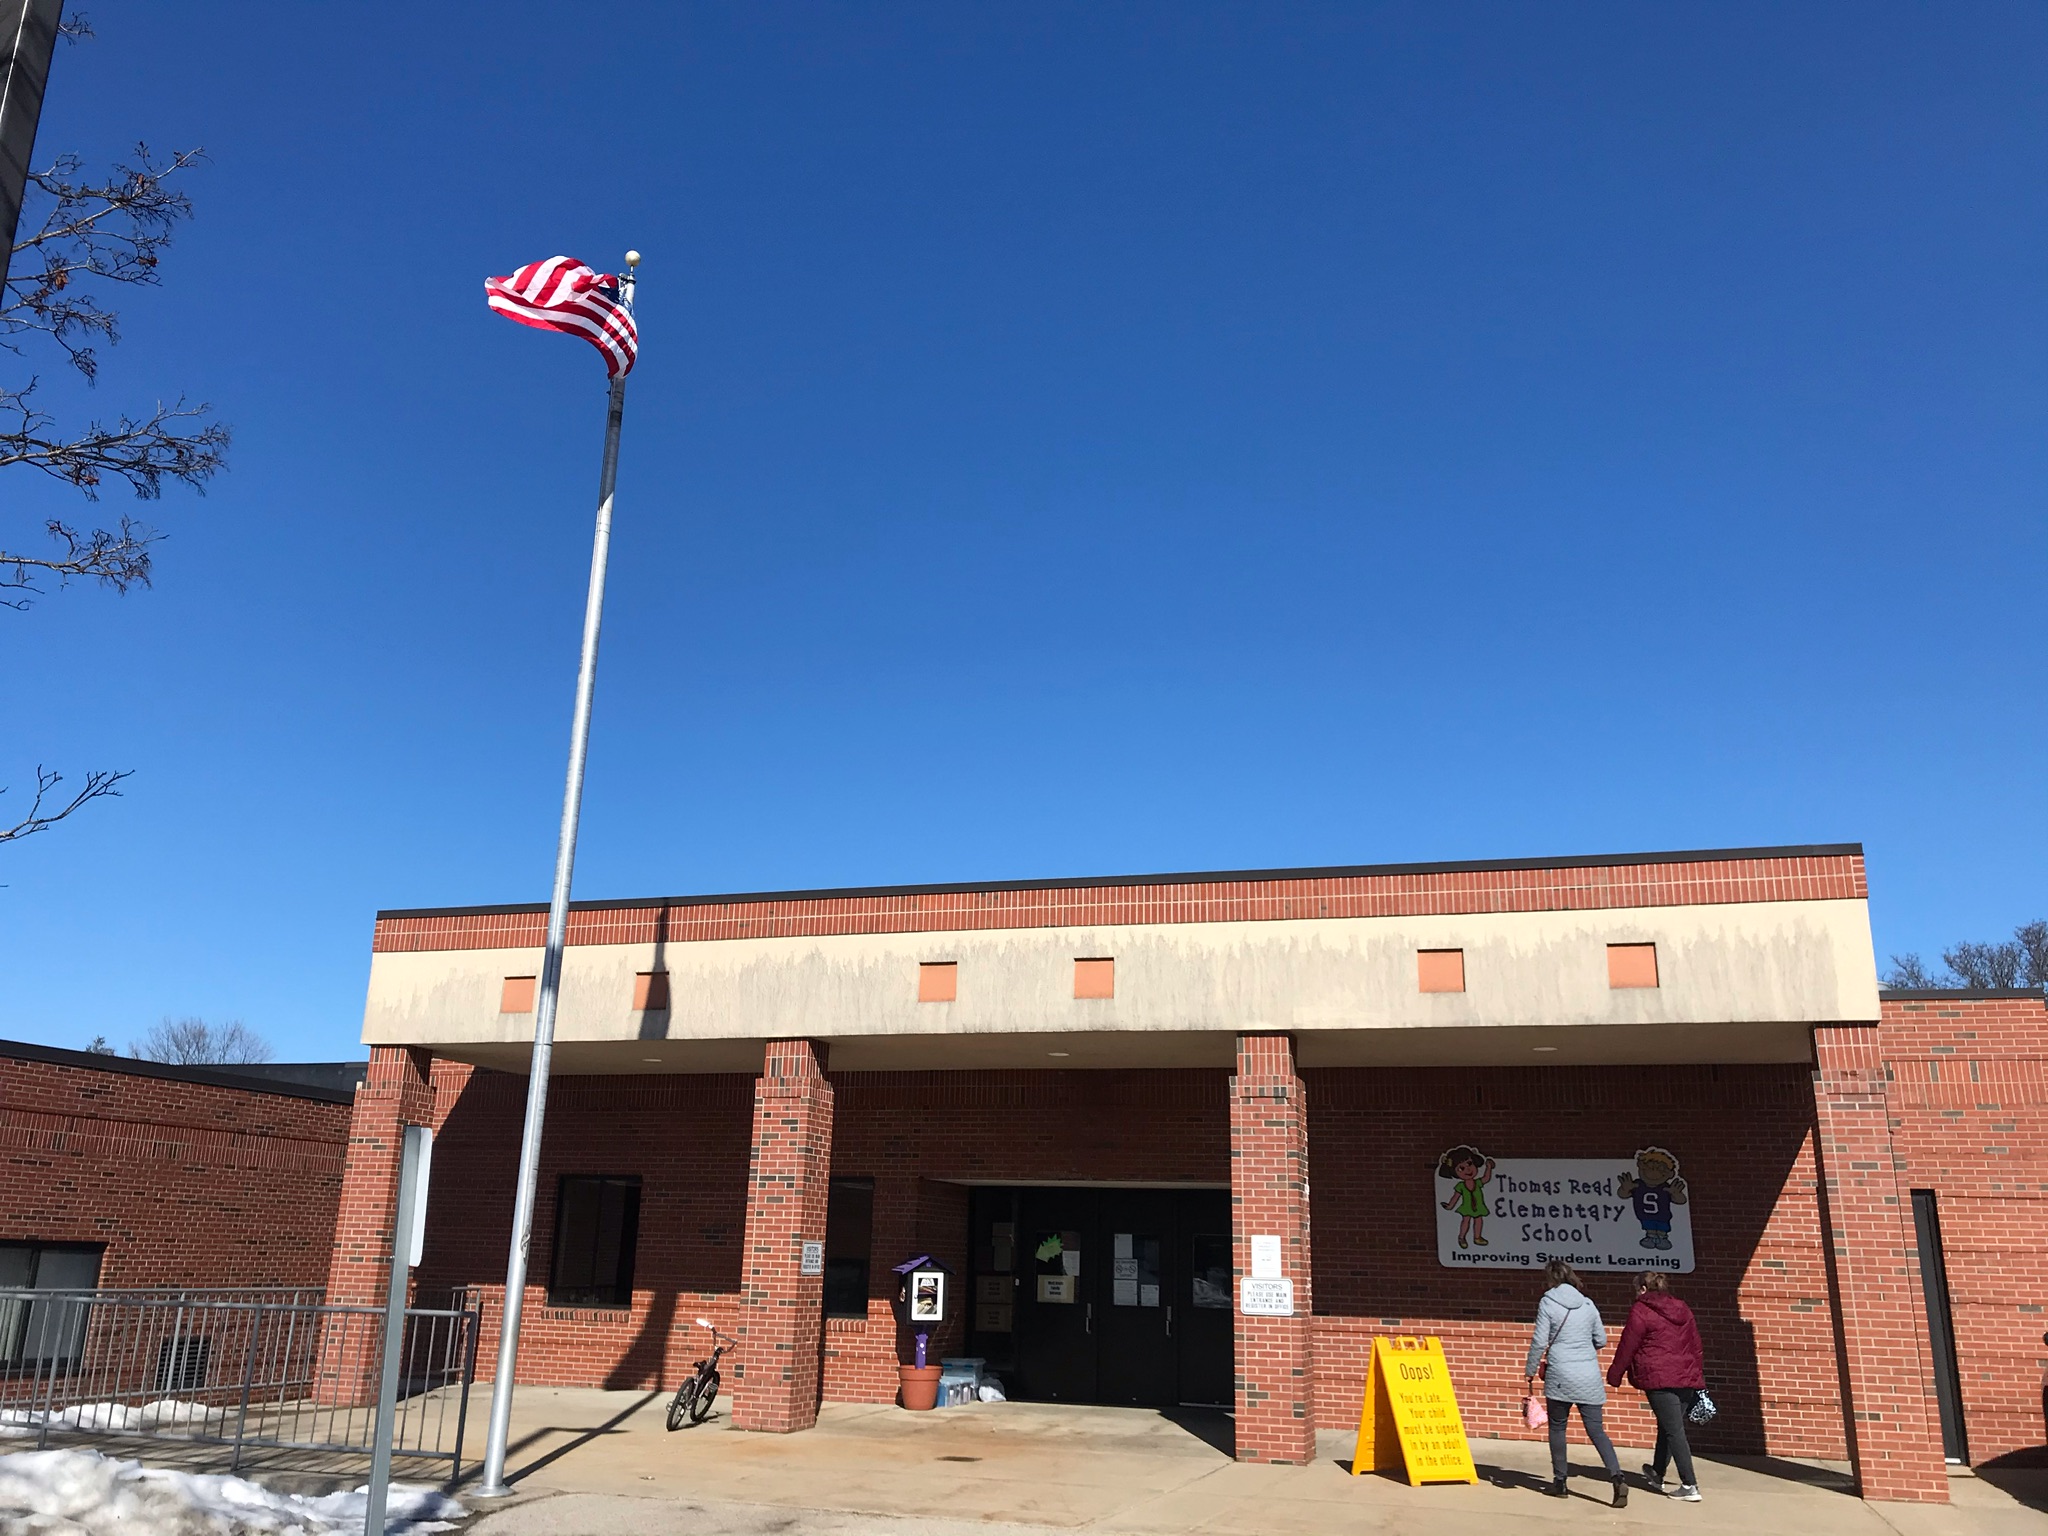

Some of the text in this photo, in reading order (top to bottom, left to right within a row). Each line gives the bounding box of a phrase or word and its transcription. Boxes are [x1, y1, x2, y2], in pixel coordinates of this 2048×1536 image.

[1495, 1174, 1613, 1197] Thomas Read
[1495, 1197, 1626, 1222] Elementary
[1643, 1193, 1660, 1214] S
[1521, 1223, 1593, 1243] School
[1452, 1251, 1681, 1270] Improving Student Learning
[1399, 1363, 1434, 1382] Oops!
[1409, 1408, 1446, 1418] Your child
[1423, 1423, 1433, 1434] be
[1419, 1439, 1429, 1451] by
[1425, 1455, 1438, 1466] the
